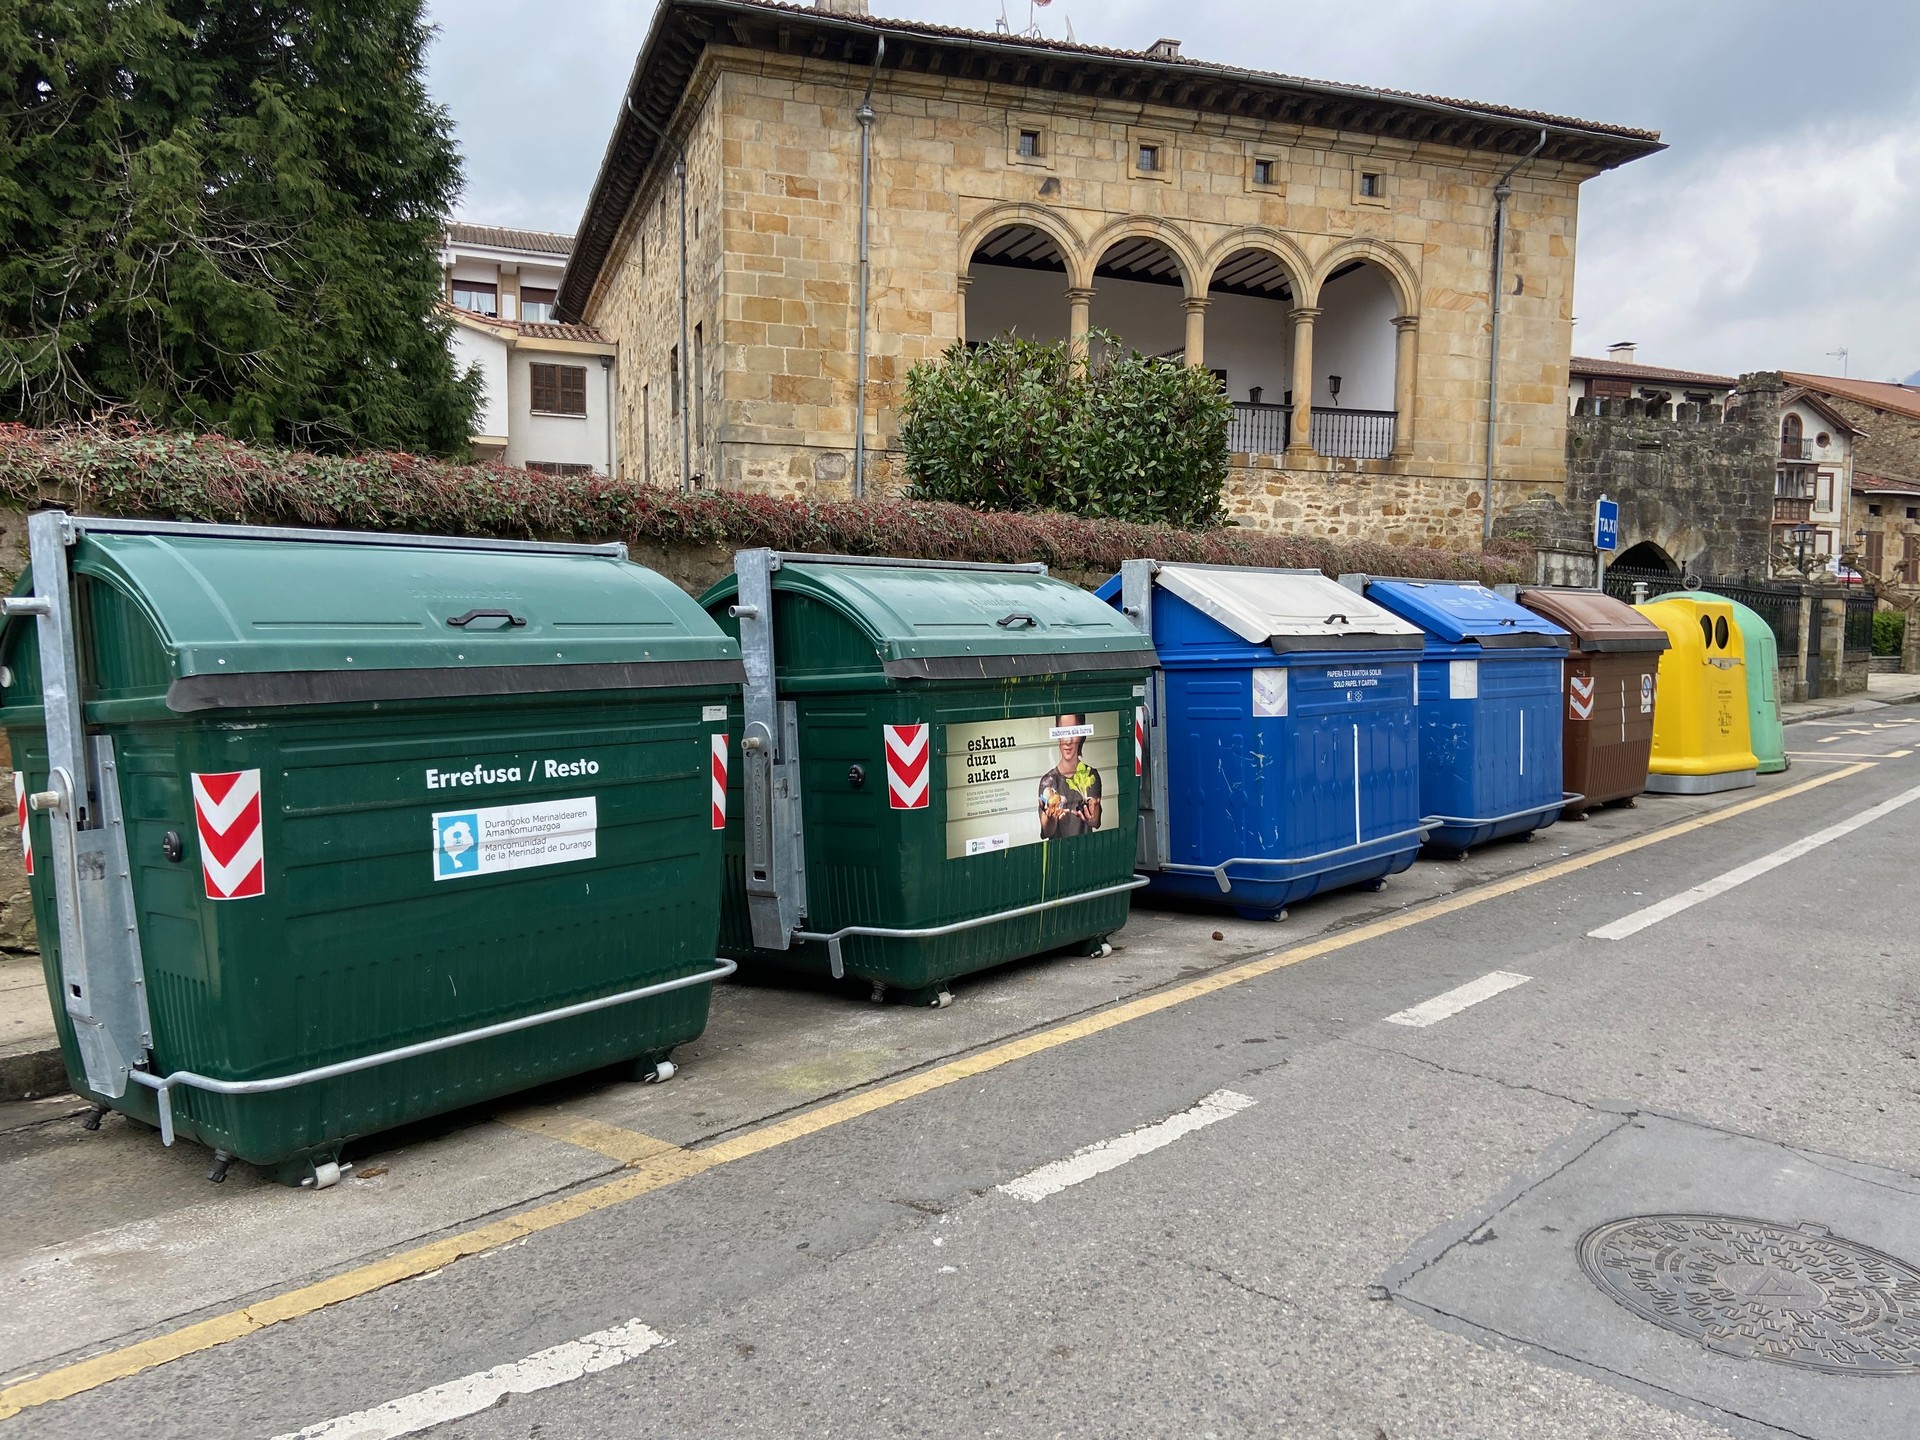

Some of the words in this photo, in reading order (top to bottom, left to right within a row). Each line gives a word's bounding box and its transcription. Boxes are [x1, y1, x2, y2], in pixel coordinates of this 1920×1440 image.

[1600, 517, 1616, 534] TAXI
[1327, 670, 1343, 678] PAPERA
[1333, 680, 1344, 688] SOLO
[1345, 680, 1358, 688] PAPEL
[968, 736, 1015, 751] eskuan
[967, 754, 996, 767] duzu
[425, 764, 521, 789] Errefusa
[528, 760, 538, 782] /
[544, 758, 599, 779] Resto
[967, 768, 1009, 783] aukera
[485, 817, 530, 829] Durangoko
[532, 810, 588, 824] Merinaldearen
[485, 822, 561, 838] Amankomunazgoa
[485, 837, 547, 852] Mancomunidad
[485, 852, 496, 862] de
[498, 851, 506, 860] la
[508, 846, 546, 859] Merindad
[547, 844, 558, 854] de
[559, 839, 592, 853] Durango
